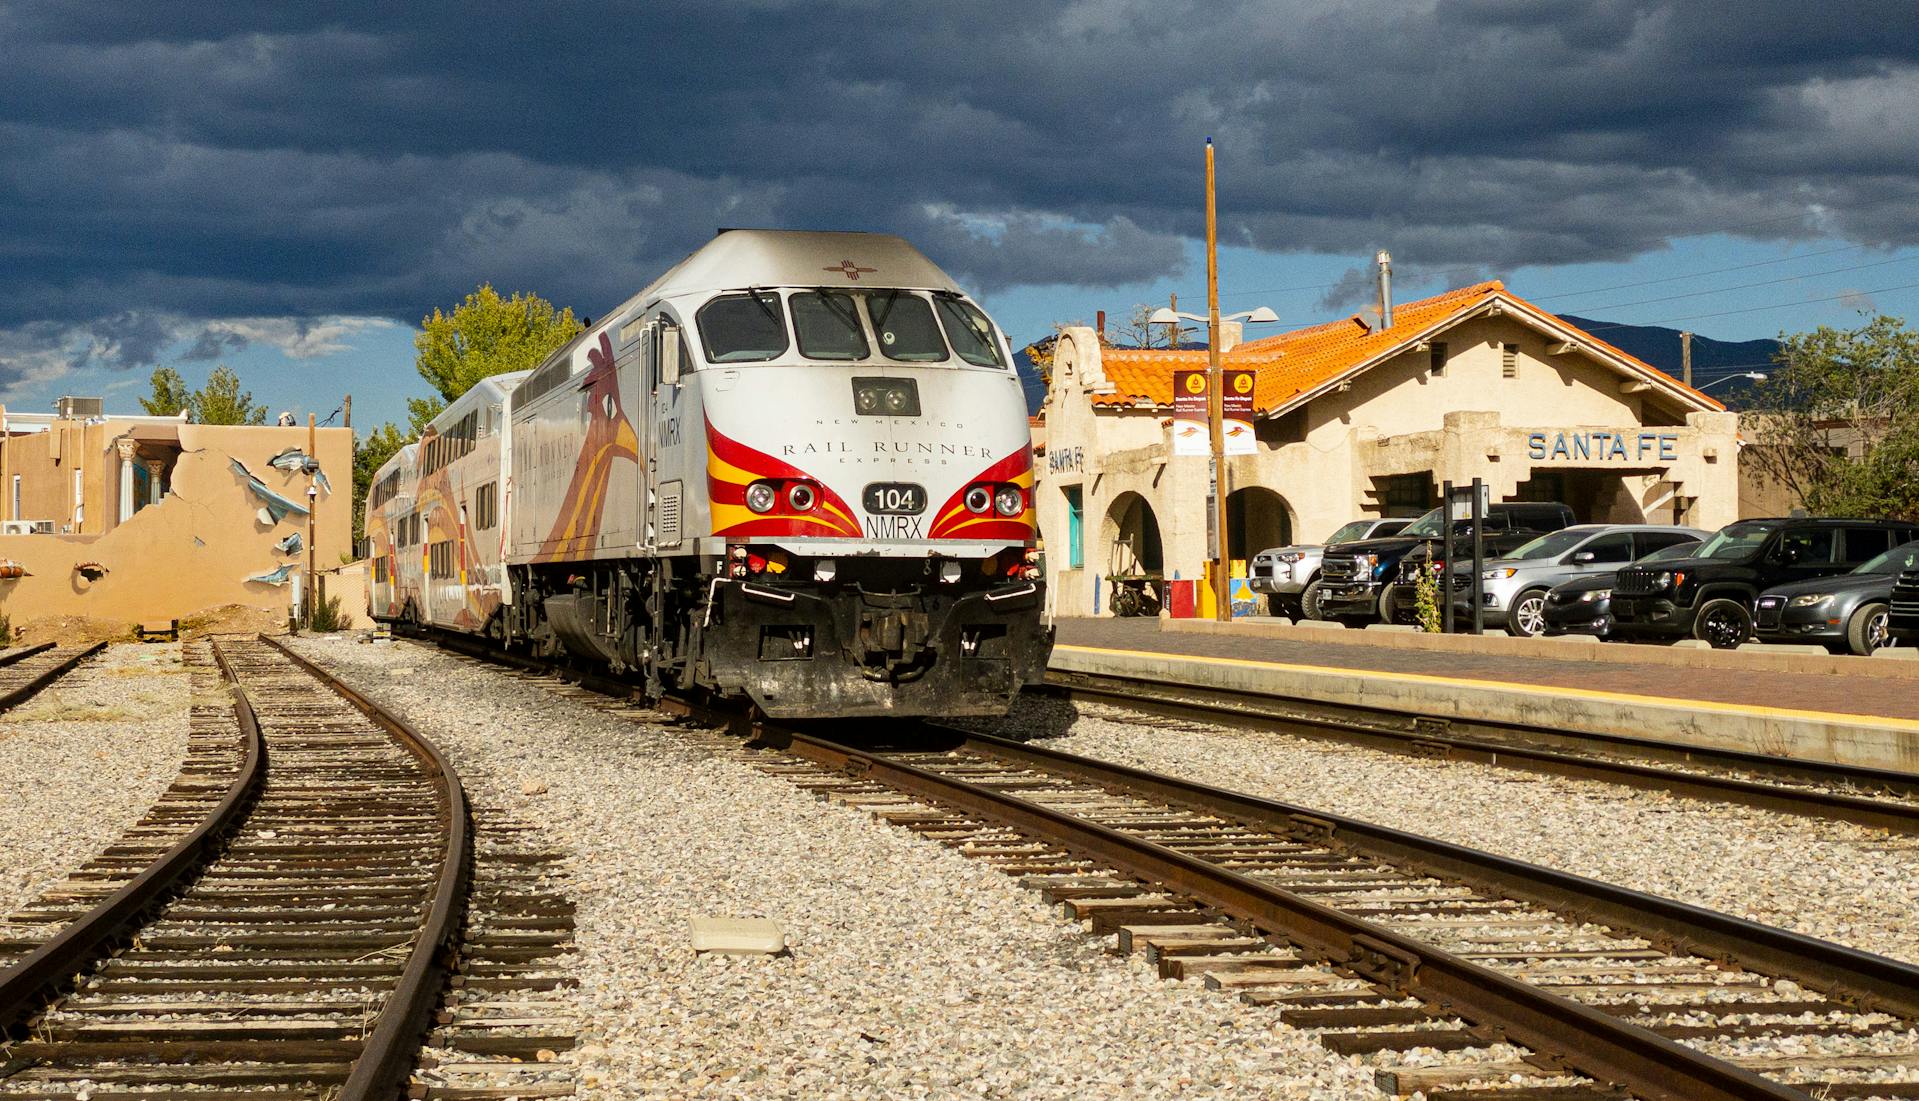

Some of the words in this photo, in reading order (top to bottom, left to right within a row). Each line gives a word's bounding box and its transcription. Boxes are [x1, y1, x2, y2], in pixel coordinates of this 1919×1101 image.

[658, 416, 681, 448] NMRX
[875, 419, 963, 429] MEXICO
[783, 442, 852, 456] RAIL
[874, 441, 993, 460] RUNNER
[1528, 432, 1627, 460] SANTA
[1638, 432, 1678, 461] FE
[839, 457, 948, 465] EXPRESS
[1049, 447, 1074, 475] SANTA
[1074, 446, 1084, 474] FE
[875, 489, 914, 509] 104
[866, 516, 922, 539] NMRX
[716, 560, 723, 575] F
